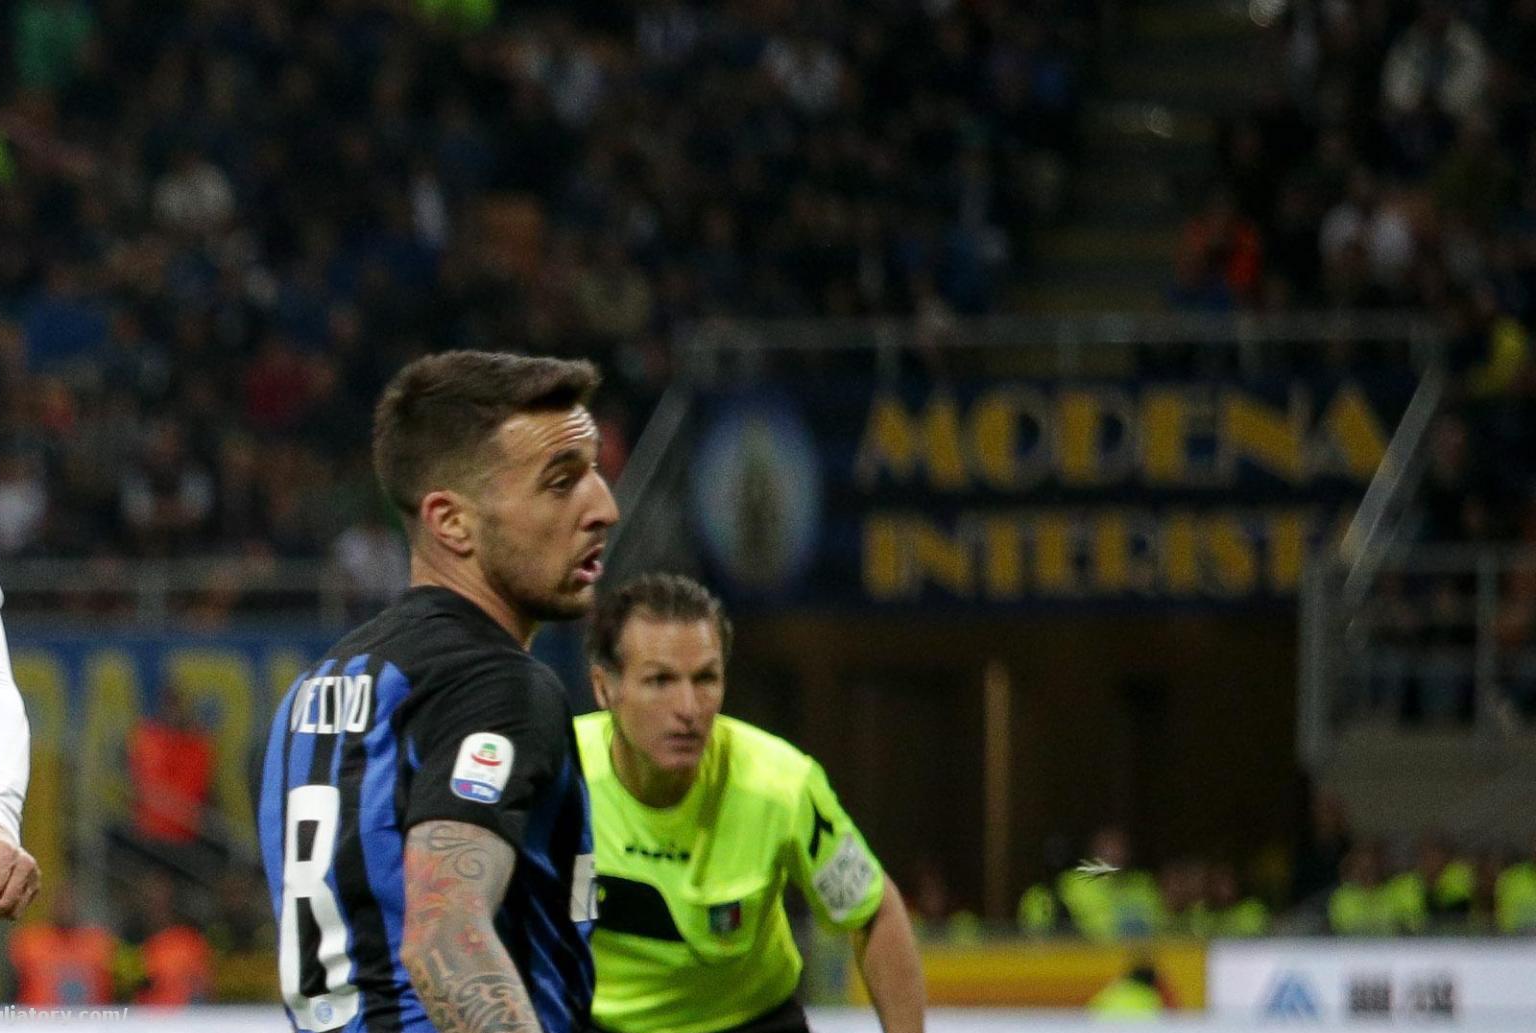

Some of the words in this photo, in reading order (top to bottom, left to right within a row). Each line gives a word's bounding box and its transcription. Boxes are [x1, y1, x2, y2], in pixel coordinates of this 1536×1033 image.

[860, 384, 1393, 489] MODENA
[864, 510, 1364, 597] INTERIST
[279, 784, 360, 1033] 8
